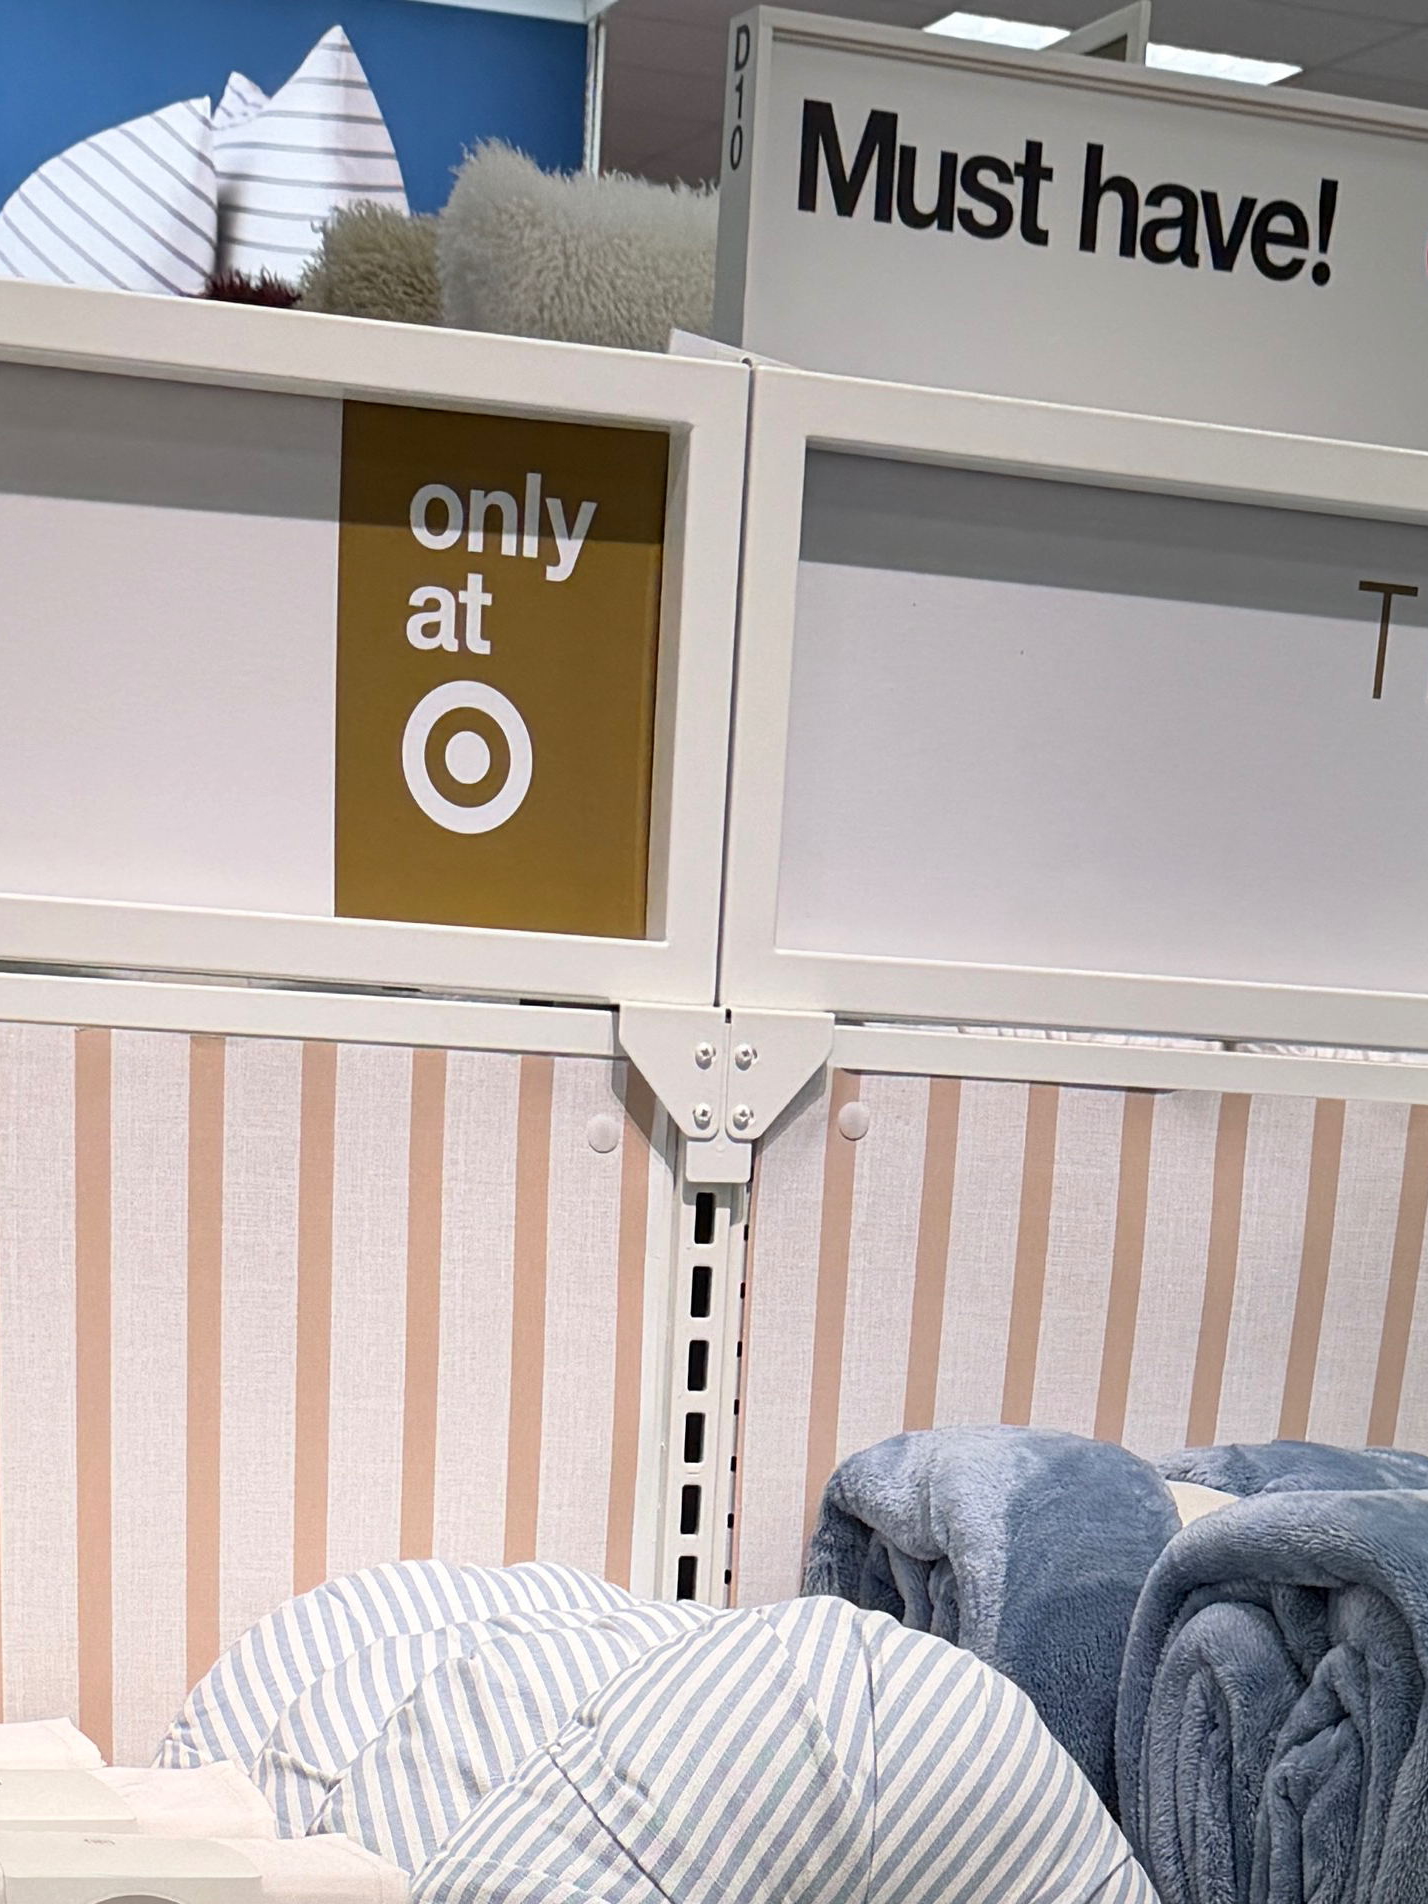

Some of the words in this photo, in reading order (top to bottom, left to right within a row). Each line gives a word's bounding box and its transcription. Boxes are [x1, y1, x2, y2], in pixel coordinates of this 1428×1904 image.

[797, 98, 1053, 246] Must
[1079, 142, 1339, 286] have!
[410, 472, 597, 582] only
[406, 573, 492, 654] at
